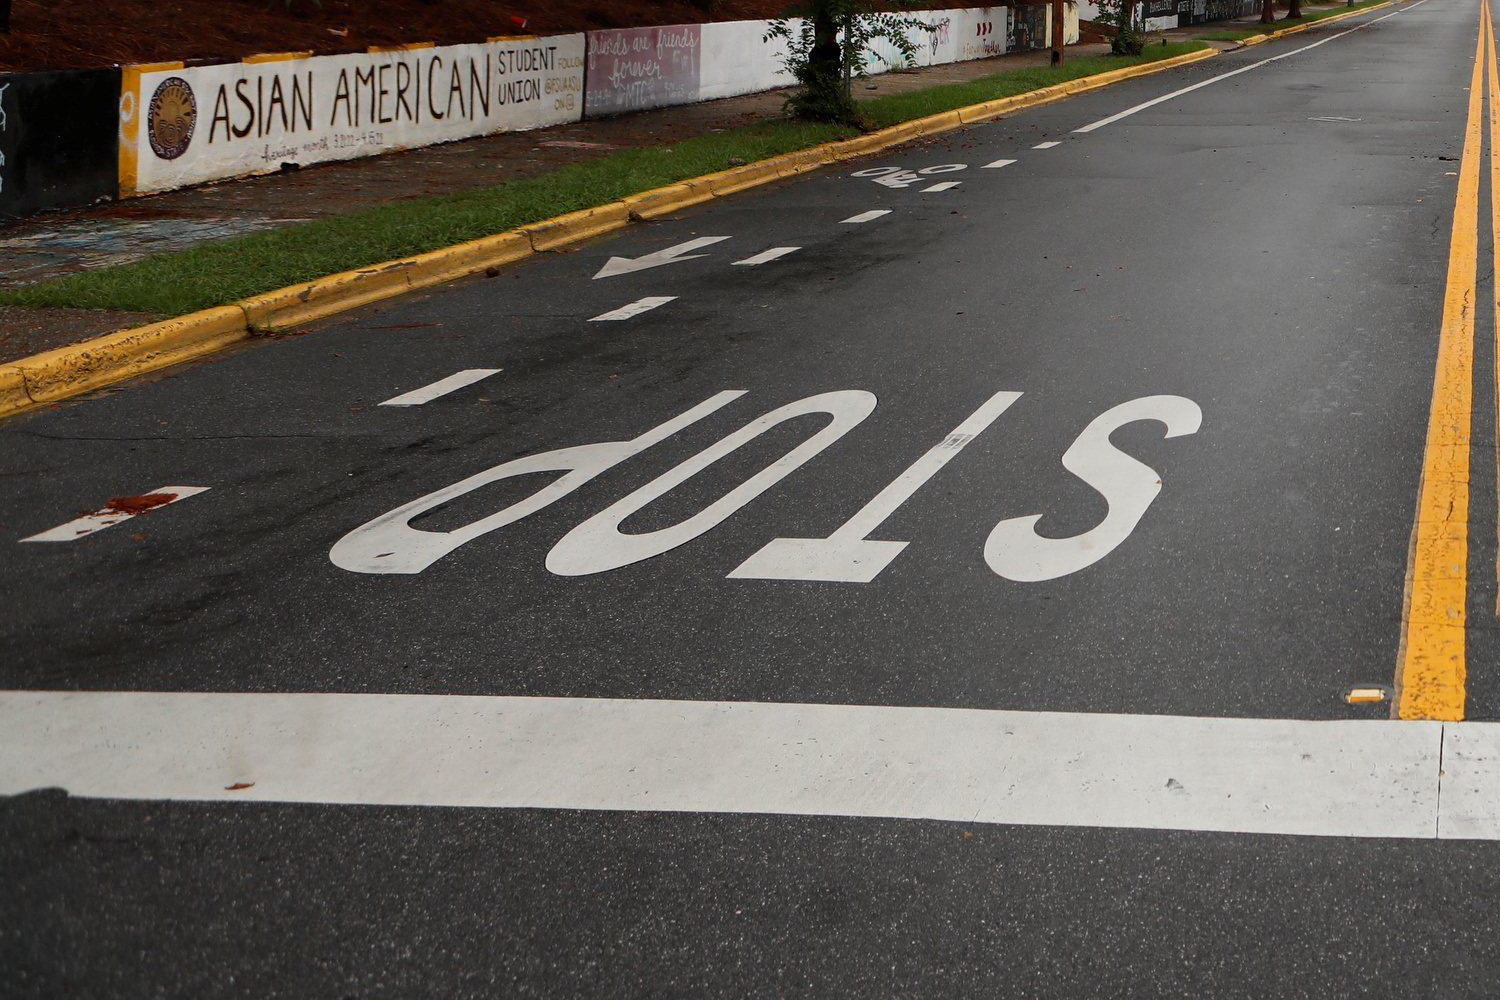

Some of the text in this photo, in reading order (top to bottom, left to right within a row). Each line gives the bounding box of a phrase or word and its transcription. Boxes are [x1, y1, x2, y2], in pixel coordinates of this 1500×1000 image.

[656, 27, 700, 60] friends
[498, 47, 556, 75] STUDENT
[208, 71, 313, 144] ASIAN
[330, 54, 490, 128] AMERICAN
[498, 79, 540, 105] UNION
[329, 389, 1203, 583] STOP
